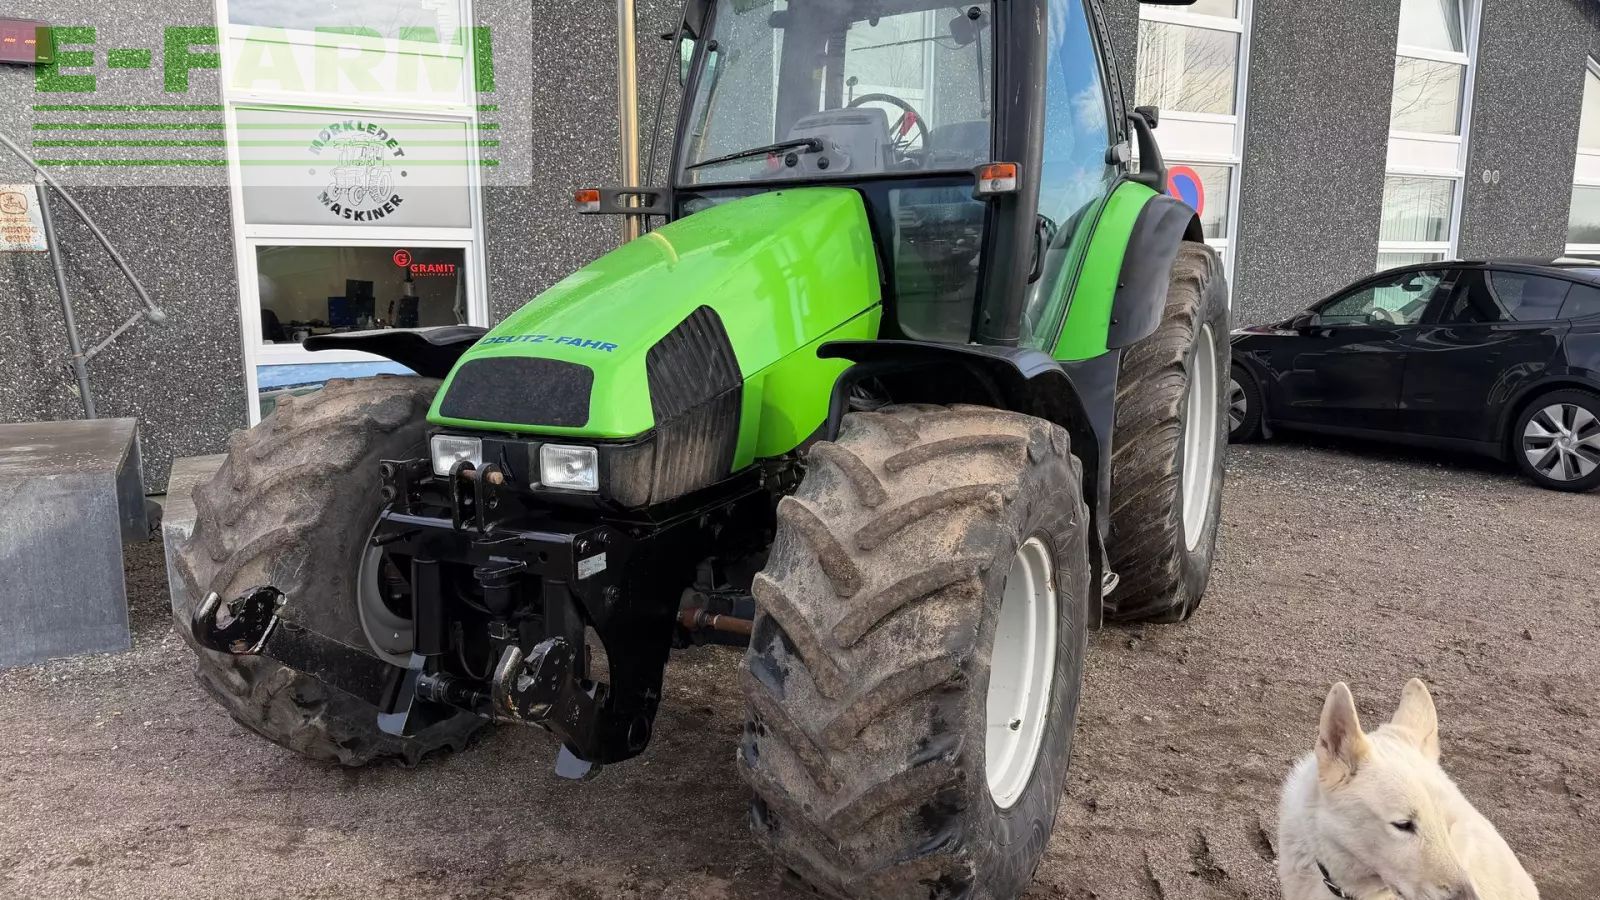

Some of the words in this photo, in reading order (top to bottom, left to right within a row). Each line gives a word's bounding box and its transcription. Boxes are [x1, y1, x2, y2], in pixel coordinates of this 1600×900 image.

[308, 120, 405, 157] MØRKLEDET
[317, 191, 404, 221] MASKINER
[410, 264, 455, 272] GRANIT
[480, 335, 618, 352] DEUTZ-FAHR
